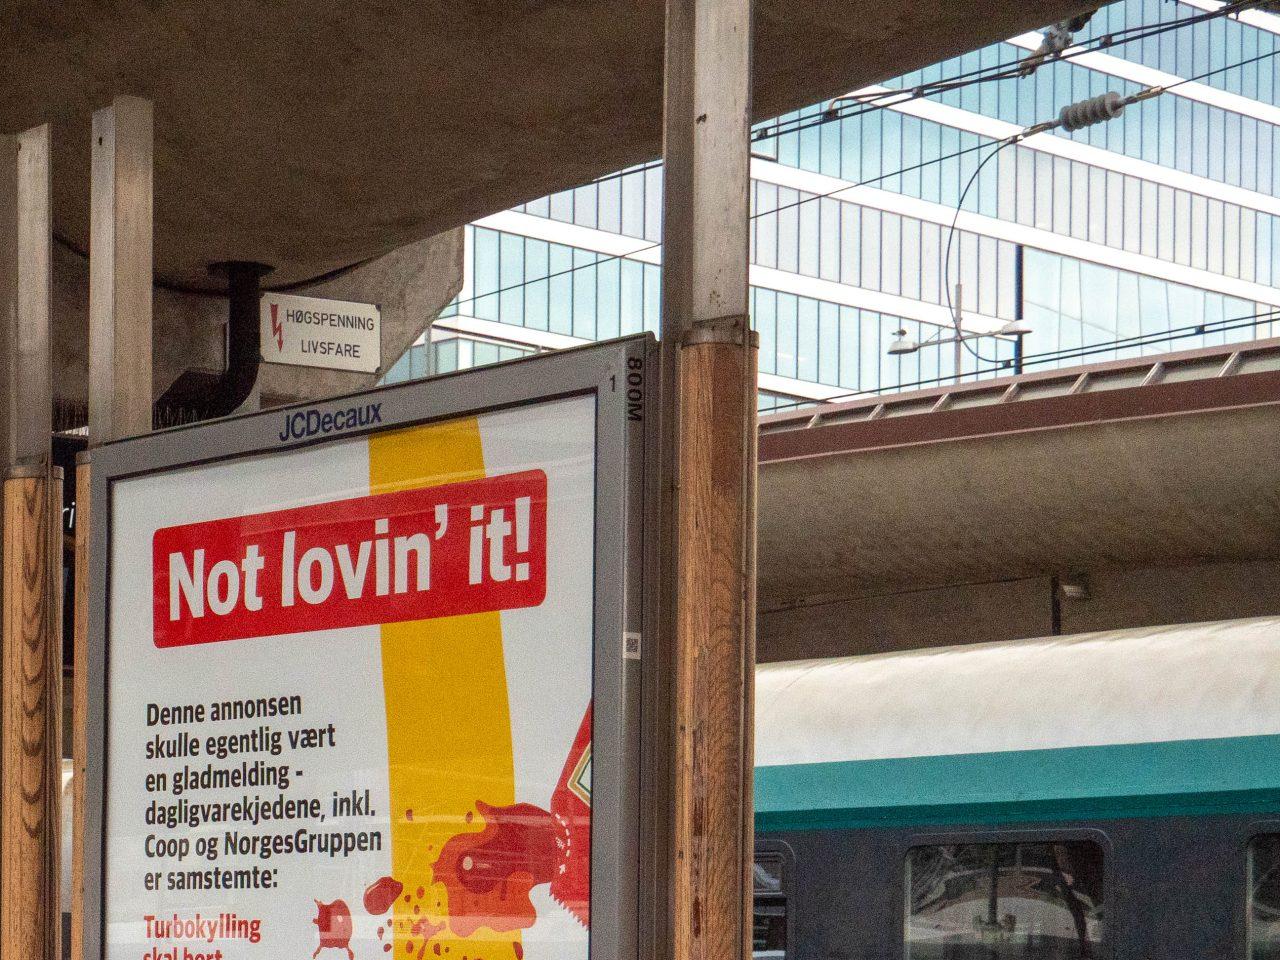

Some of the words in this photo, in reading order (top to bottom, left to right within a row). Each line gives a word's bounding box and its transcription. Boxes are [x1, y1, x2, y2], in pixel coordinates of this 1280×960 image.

[286, 309, 375, 330] HØGSPENNING
[301, 340, 361, 358] LIVSFARE
[628, 358, 642, 422] 800M
[279, 403, 382, 442] JCDecaux
[168, 546, 264, 622] Not
[283, 504, 448, 606] lovin'
[468, 496, 531, 586] it!
[146, 700, 205, 726] Denne
[211, 694, 302, 722] annonsen
[145, 732, 199, 759] skulle
[206, 726, 282, 758] egentlig
[288, 724, 336, 750] vært
[145, 773, 166, 792] en
[172, 763, 289, 795] gladmelding
[145, 797, 326, 828] dagligvarekjedene,
[332, 790, 376, 818] inkl.
[144, 833, 190, 861] Coop
[196, 838, 218, 860] og
[224, 828, 381, 857] NorgesGruppen
[144, 872, 162, 890] er
[167, 867, 278, 890] samstemte:
[144, 914, 261, 942] Turbokylling
